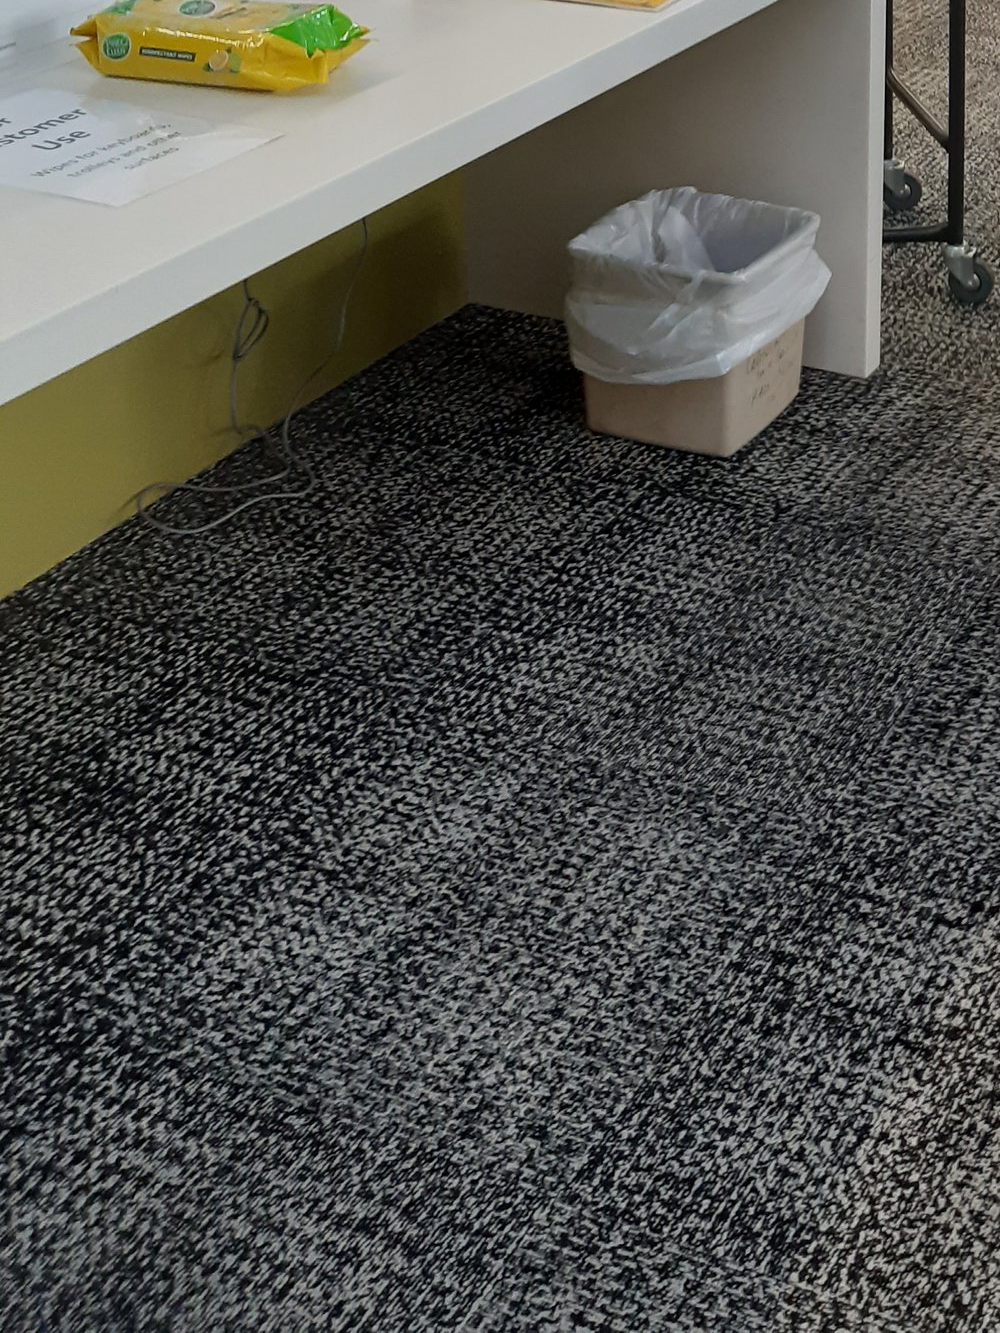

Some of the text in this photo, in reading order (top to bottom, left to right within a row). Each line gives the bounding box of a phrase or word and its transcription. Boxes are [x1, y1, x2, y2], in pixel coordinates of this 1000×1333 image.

[0, 108, 87, 147] stomer
[32, 130, 91, 152] Use
[31, 158, 79, 178] Wipes
